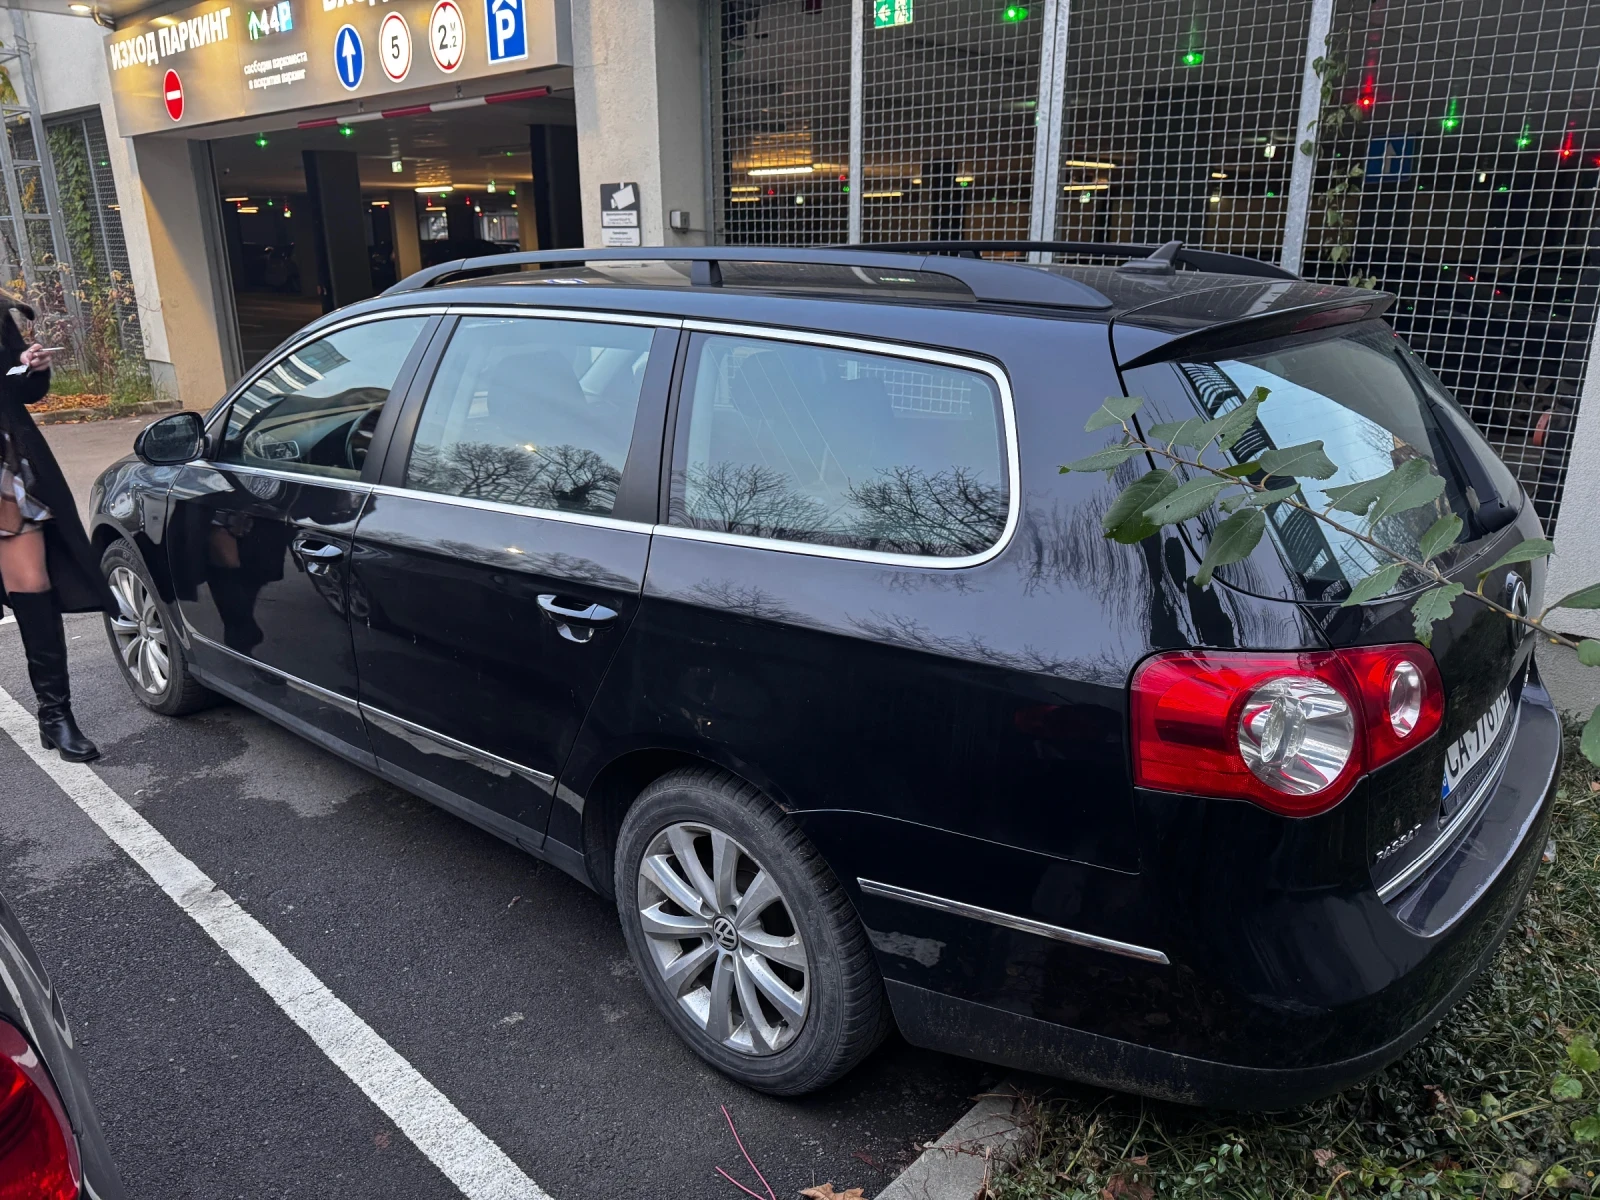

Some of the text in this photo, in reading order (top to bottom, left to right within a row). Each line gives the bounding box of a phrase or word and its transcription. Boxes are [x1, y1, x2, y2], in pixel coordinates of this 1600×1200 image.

[110, 7, 231, 71] ИЗХОД ПАРКИНГ
[391, 35, 400, 59] 5
